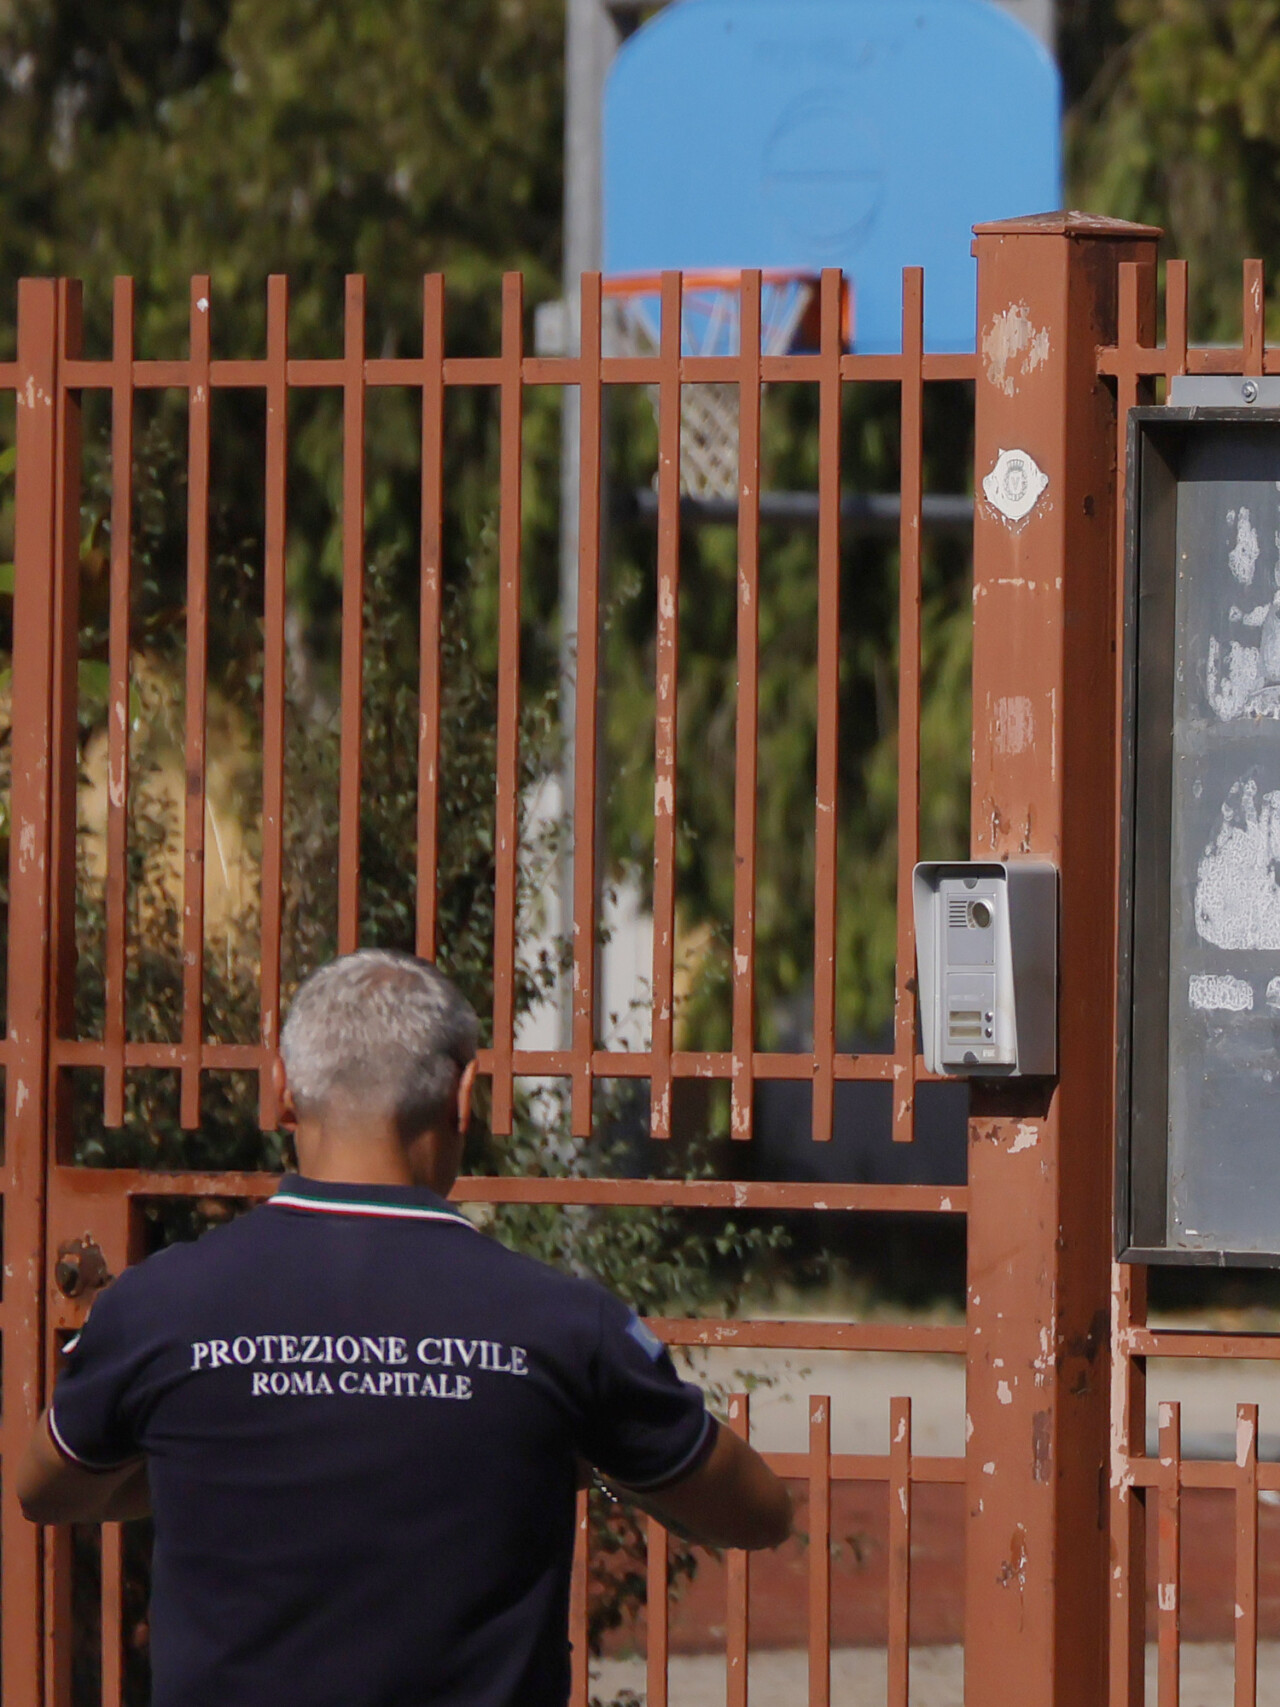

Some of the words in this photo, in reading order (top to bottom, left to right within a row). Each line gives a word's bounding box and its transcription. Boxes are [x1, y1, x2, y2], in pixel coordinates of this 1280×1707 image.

[190, 1335, 409, 1370] PROTEZIONE
[416, 1337, 529, 1375] CIVILE
[251, 1371, 334, 1396] ROMA
[339, 1371, 473, 1400] CAPITALE
